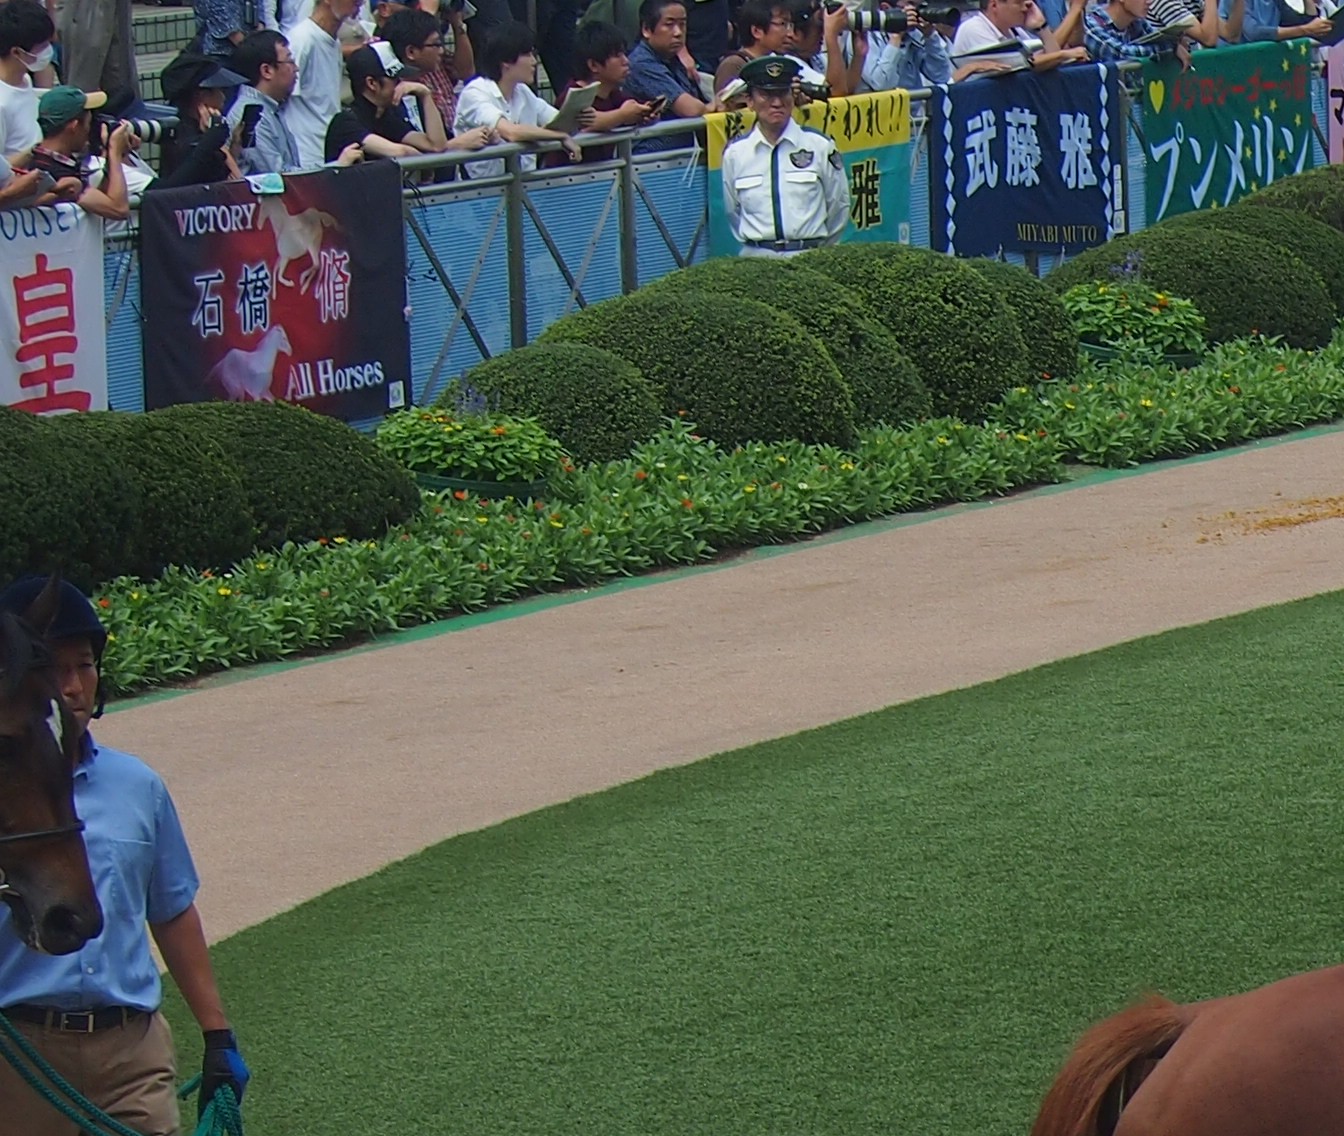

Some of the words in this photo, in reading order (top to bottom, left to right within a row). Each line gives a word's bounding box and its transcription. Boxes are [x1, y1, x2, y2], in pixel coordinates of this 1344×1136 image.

[174, 203, 256, 237] VICTORY
[1017, 223, 1059, 244] MIYABI
[1062, 225, 1098, 244] MUTO
[191, 261, 271, 338] 石橋
[285, 362, 317, 400] All
[317, 359, 385, 396] Horses
